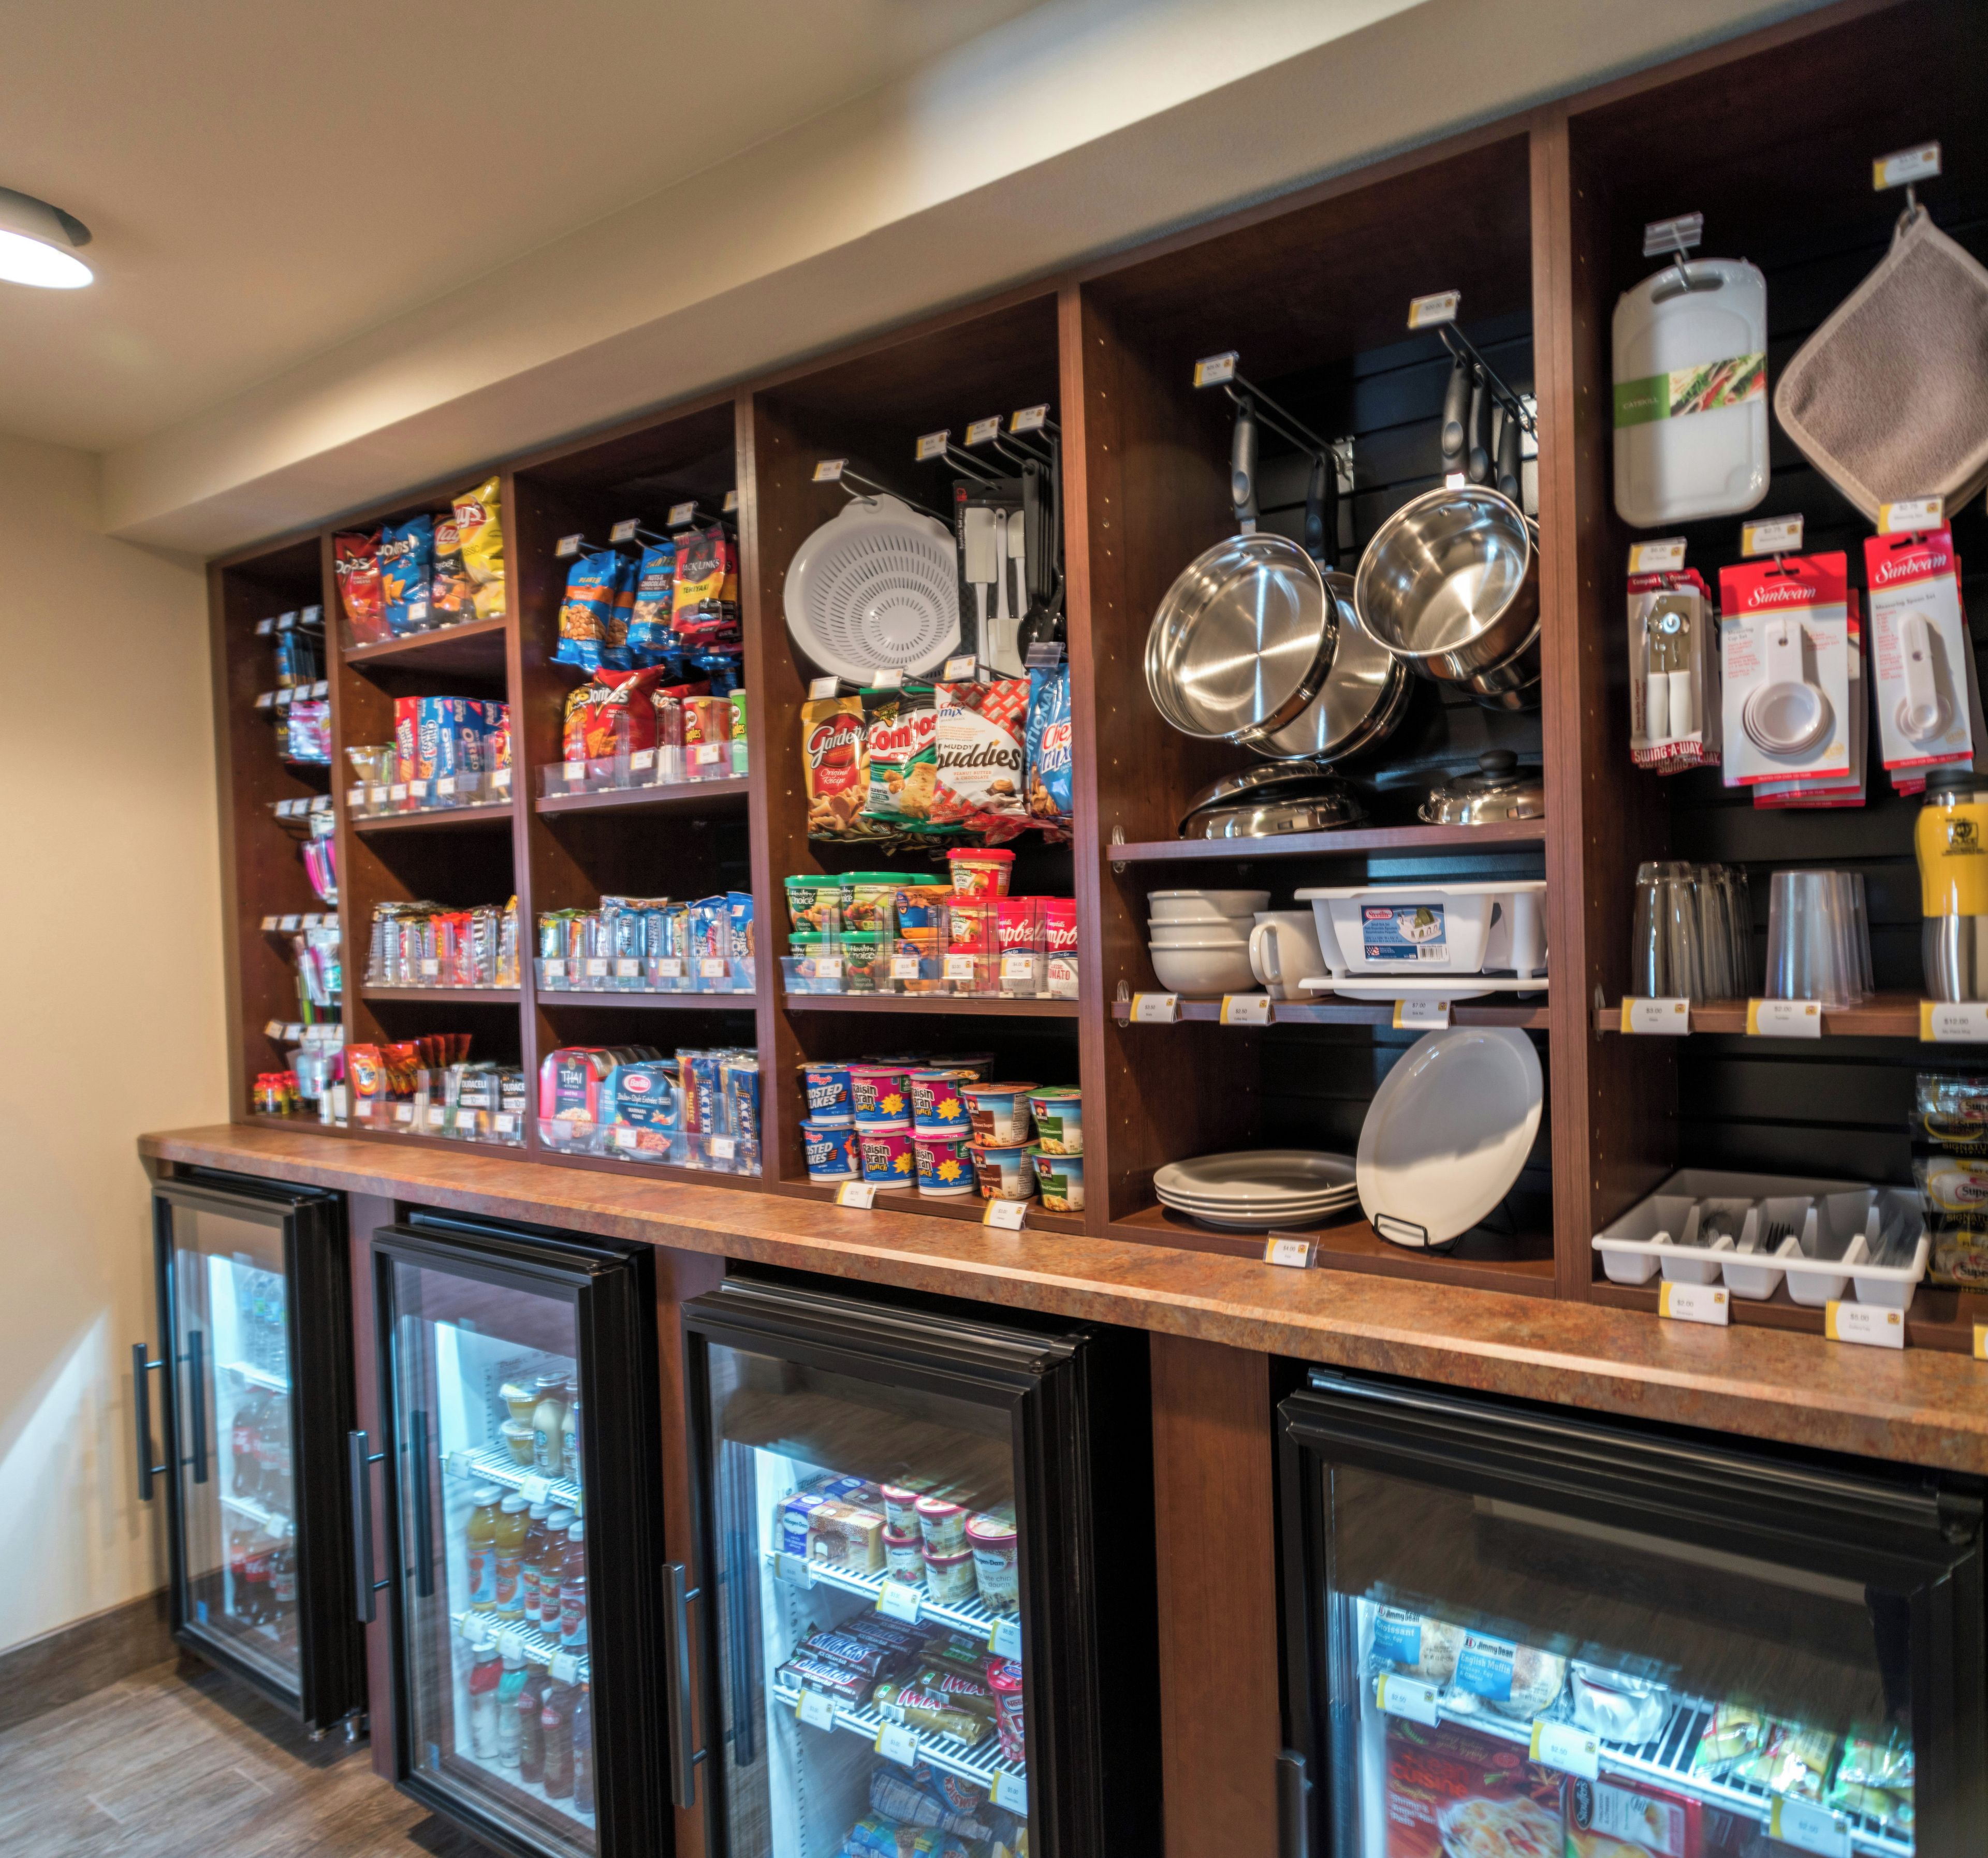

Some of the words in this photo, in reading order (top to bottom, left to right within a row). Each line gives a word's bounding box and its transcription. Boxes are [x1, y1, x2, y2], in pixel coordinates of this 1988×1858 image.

[1875, 553, 1947, 584] Sunbeam
[683, 584, 709, 594] TERIYAKI
[1747, 584, 1816, 607] Sunbeam
[940, 707, 965, 717] mix
[820, 767, 850, 777] Original
[823, 775, 846, 786] Recipe
[791, 889, 816, 898] Healthy
[791, 896, 814, 904] Choice
[561, 1070, 582, 1084] THAI
[630, 1079, 650, 1089] Barilla
[854, 1093, 876, 1104] Bran
[628, 1107, 647, 1115] MARINARA
[862, 1144, 891, 1156] Raisin
[865, 1154, 888, 1165] Bran
[866, 1164, 888, 1173] Crunch
[1385, 1610, 1405, 1621] Jimmy
[1376, 1619, 1415, 1636] Croissant
[1477, 1641, 1498, 1656] Jimmy
[1498, 1647, 1513, 1658] Dean
[1460, 1653, 1486, 1666] English
[1487, 1660, 1511, 1675] Muffin
[896, 1687, 942, 1710] TWIX
[1391, 1693, 1406, 1703] $2.50
[1551, 1745, 1568, 1755] $2.50
